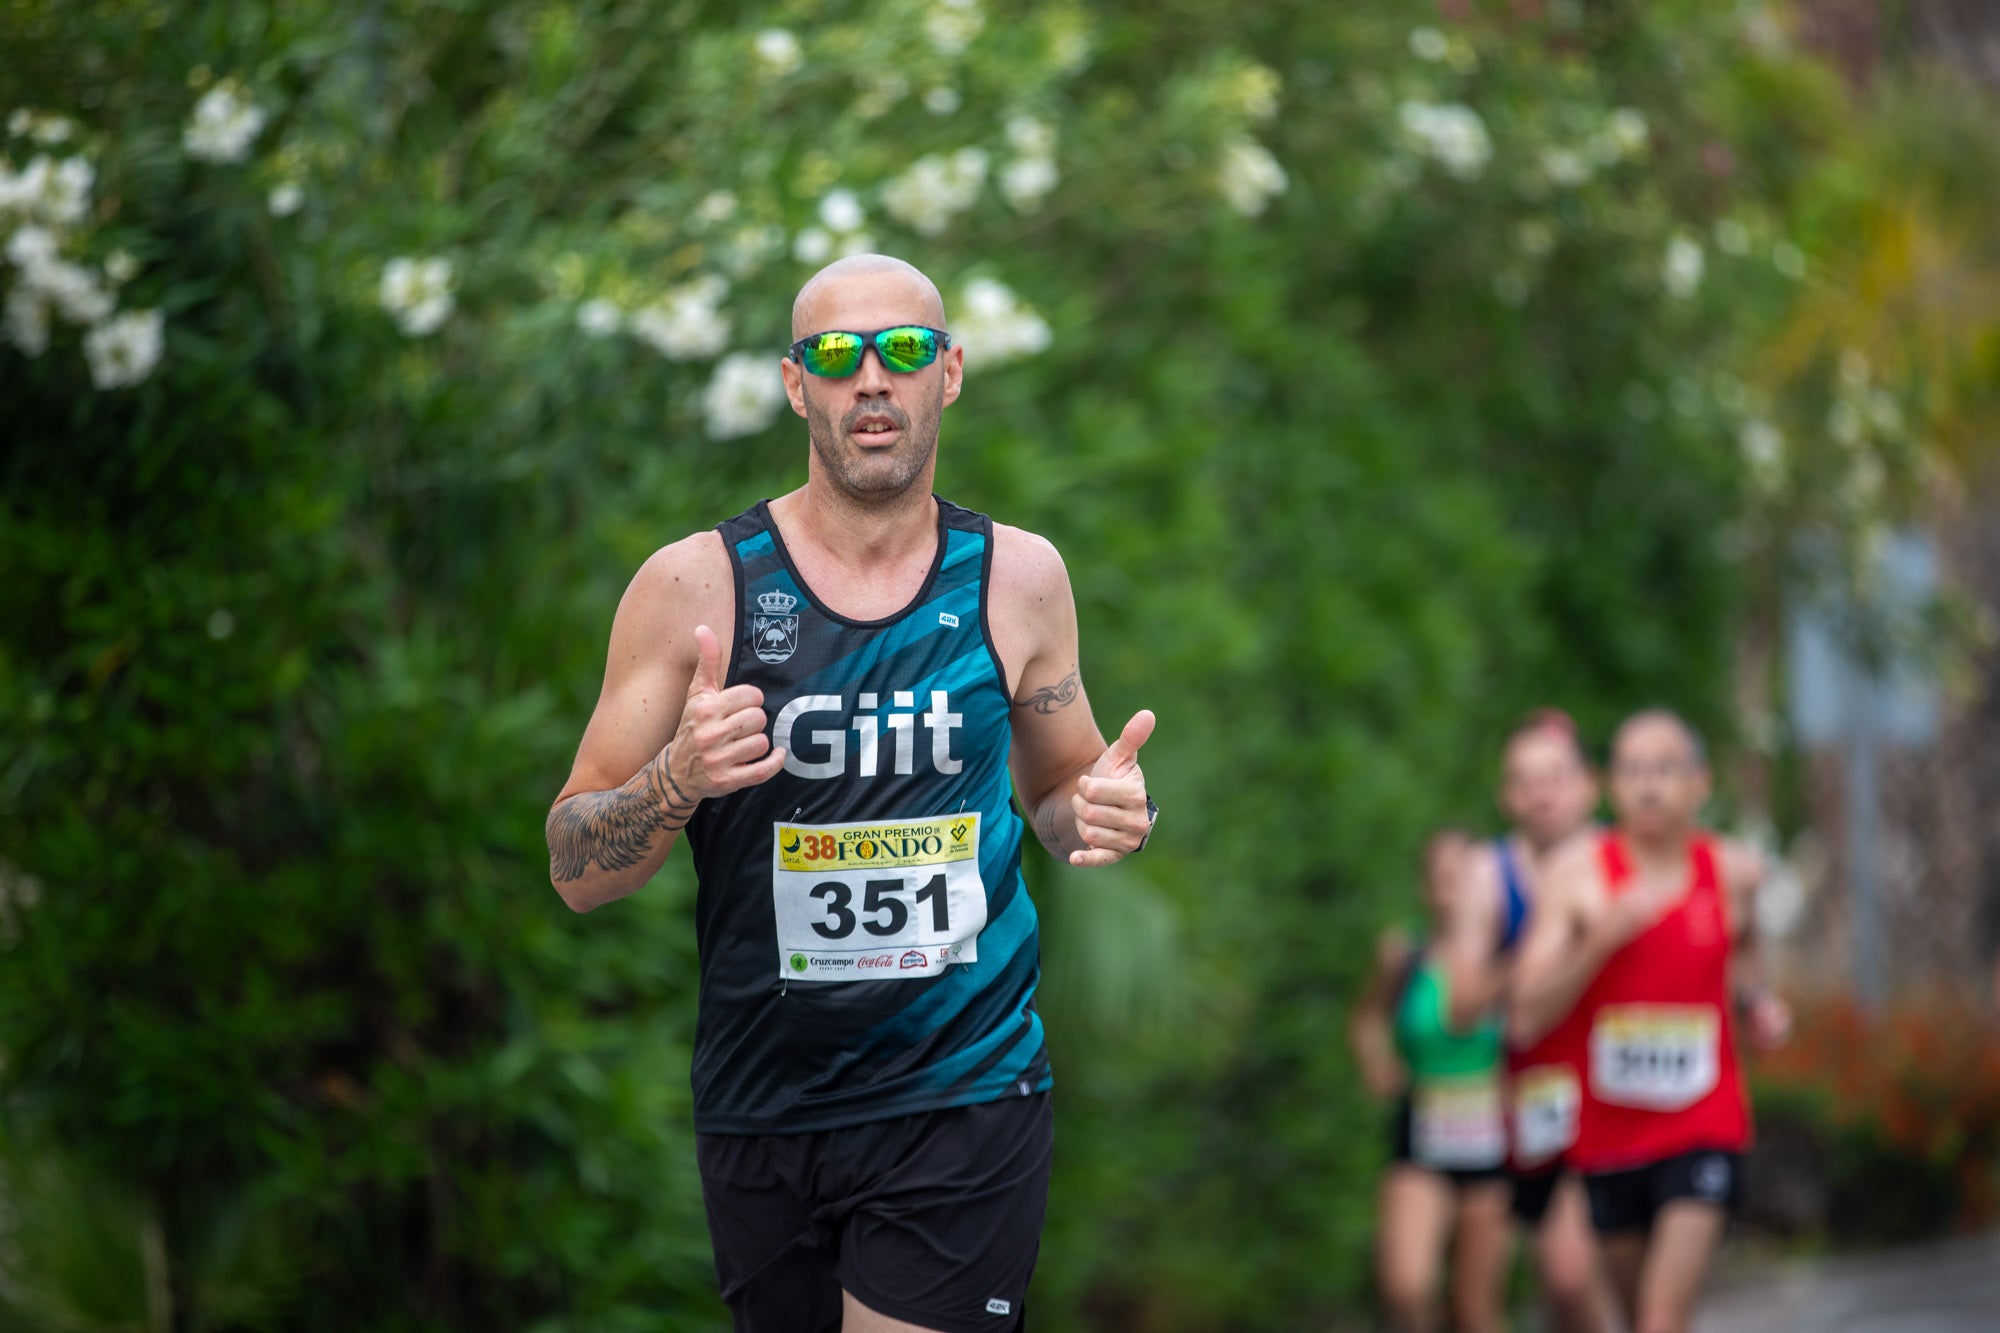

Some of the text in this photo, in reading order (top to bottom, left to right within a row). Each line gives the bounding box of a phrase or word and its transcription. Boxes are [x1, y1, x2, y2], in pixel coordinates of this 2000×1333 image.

[772, 690, 963, 780] Giit
[843, 832, 881, 840] GRAN
[885, 826, 933, 838] PREMIO
[803, 835, 836, 861] 38
[837, 835, 943, 861] FONDO
[809, 873, 949, 940] 351
[810, 957, 854, 967] Cruzcampo
[857, 954, 895, 969] Coca-Cola
